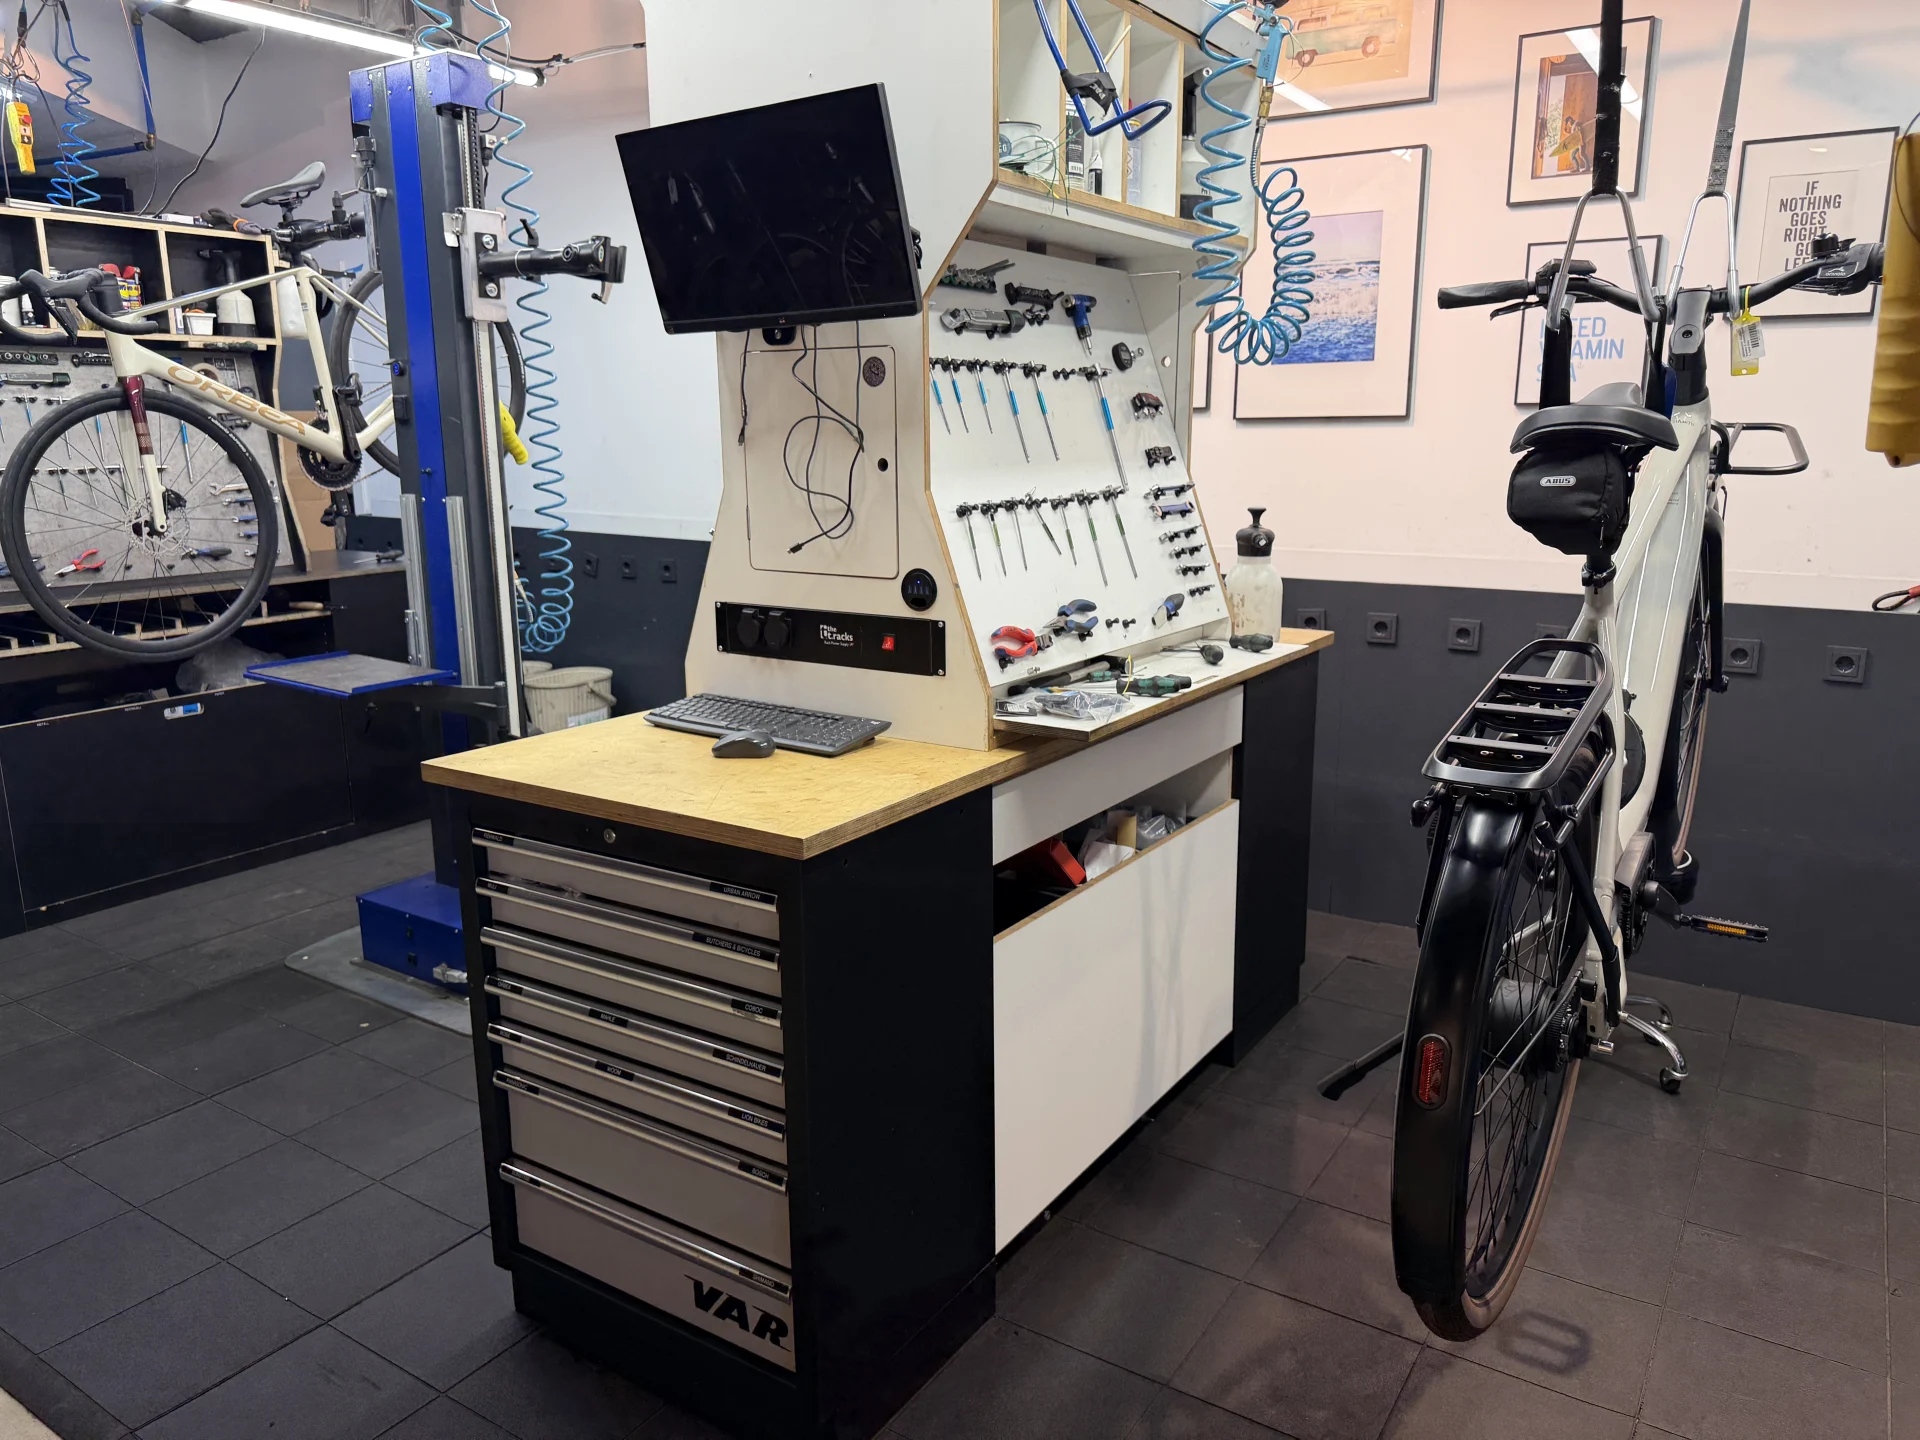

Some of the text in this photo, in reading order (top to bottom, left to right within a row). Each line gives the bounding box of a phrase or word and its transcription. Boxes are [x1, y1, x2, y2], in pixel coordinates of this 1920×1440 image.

[1805, 180, 1819, 196] IF
[1779, 194, 1842, 213] NOTHING
[1790, 210, 1827, 227] GOES
[1784, 256, 1812, 272] LEF
[168, 365, 306, 437] ORBEA
[827, 625, 837, 633] the
[723, 886, 761, 900] URBAN ARROW
[705, 936, 732, 950] BUTCHERS
[736, 944, 761, 957] BICYCLES
[744, 1003, 764, 1015] COBOC
[600, 1012, 616, 1023] MAHLE
[725, 1053, 767, 1072] SCHINDELHAUER
[741, 1112, 769, 1128] LION BIKES
[751, 1167, 770, 1180] BOSCH
[752, 1273, 775, 1288] SHIMANO
[685, 1275, 791, 1352] VAR
